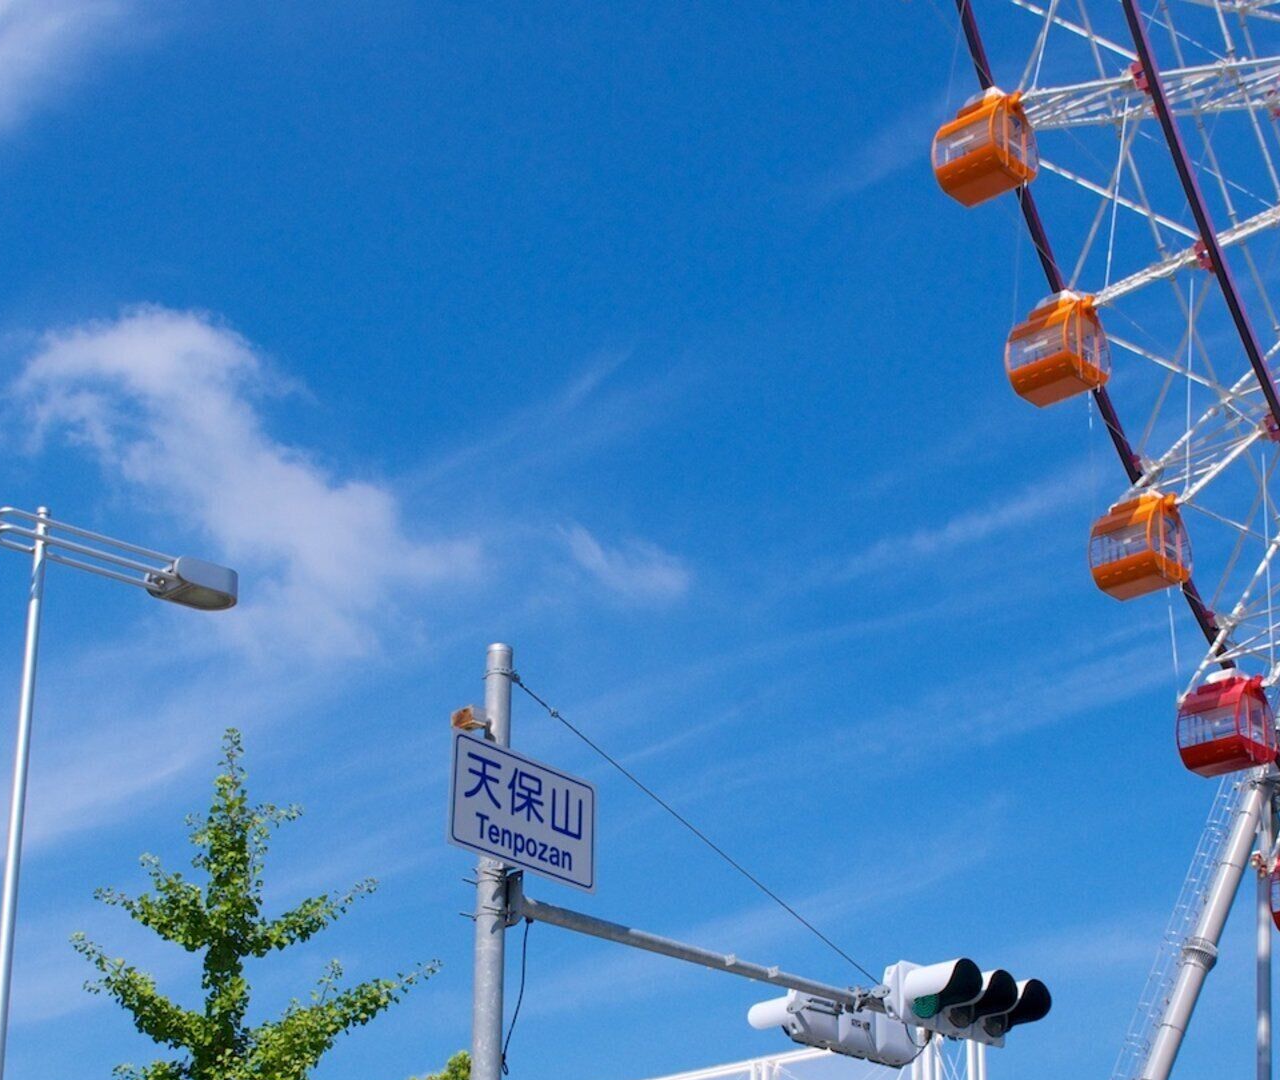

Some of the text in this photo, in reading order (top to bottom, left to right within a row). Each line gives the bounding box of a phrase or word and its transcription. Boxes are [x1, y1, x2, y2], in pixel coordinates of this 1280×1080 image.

[464, 752, 584, 841] 天保山
[475, 812, 573, 871] Tenpozan
